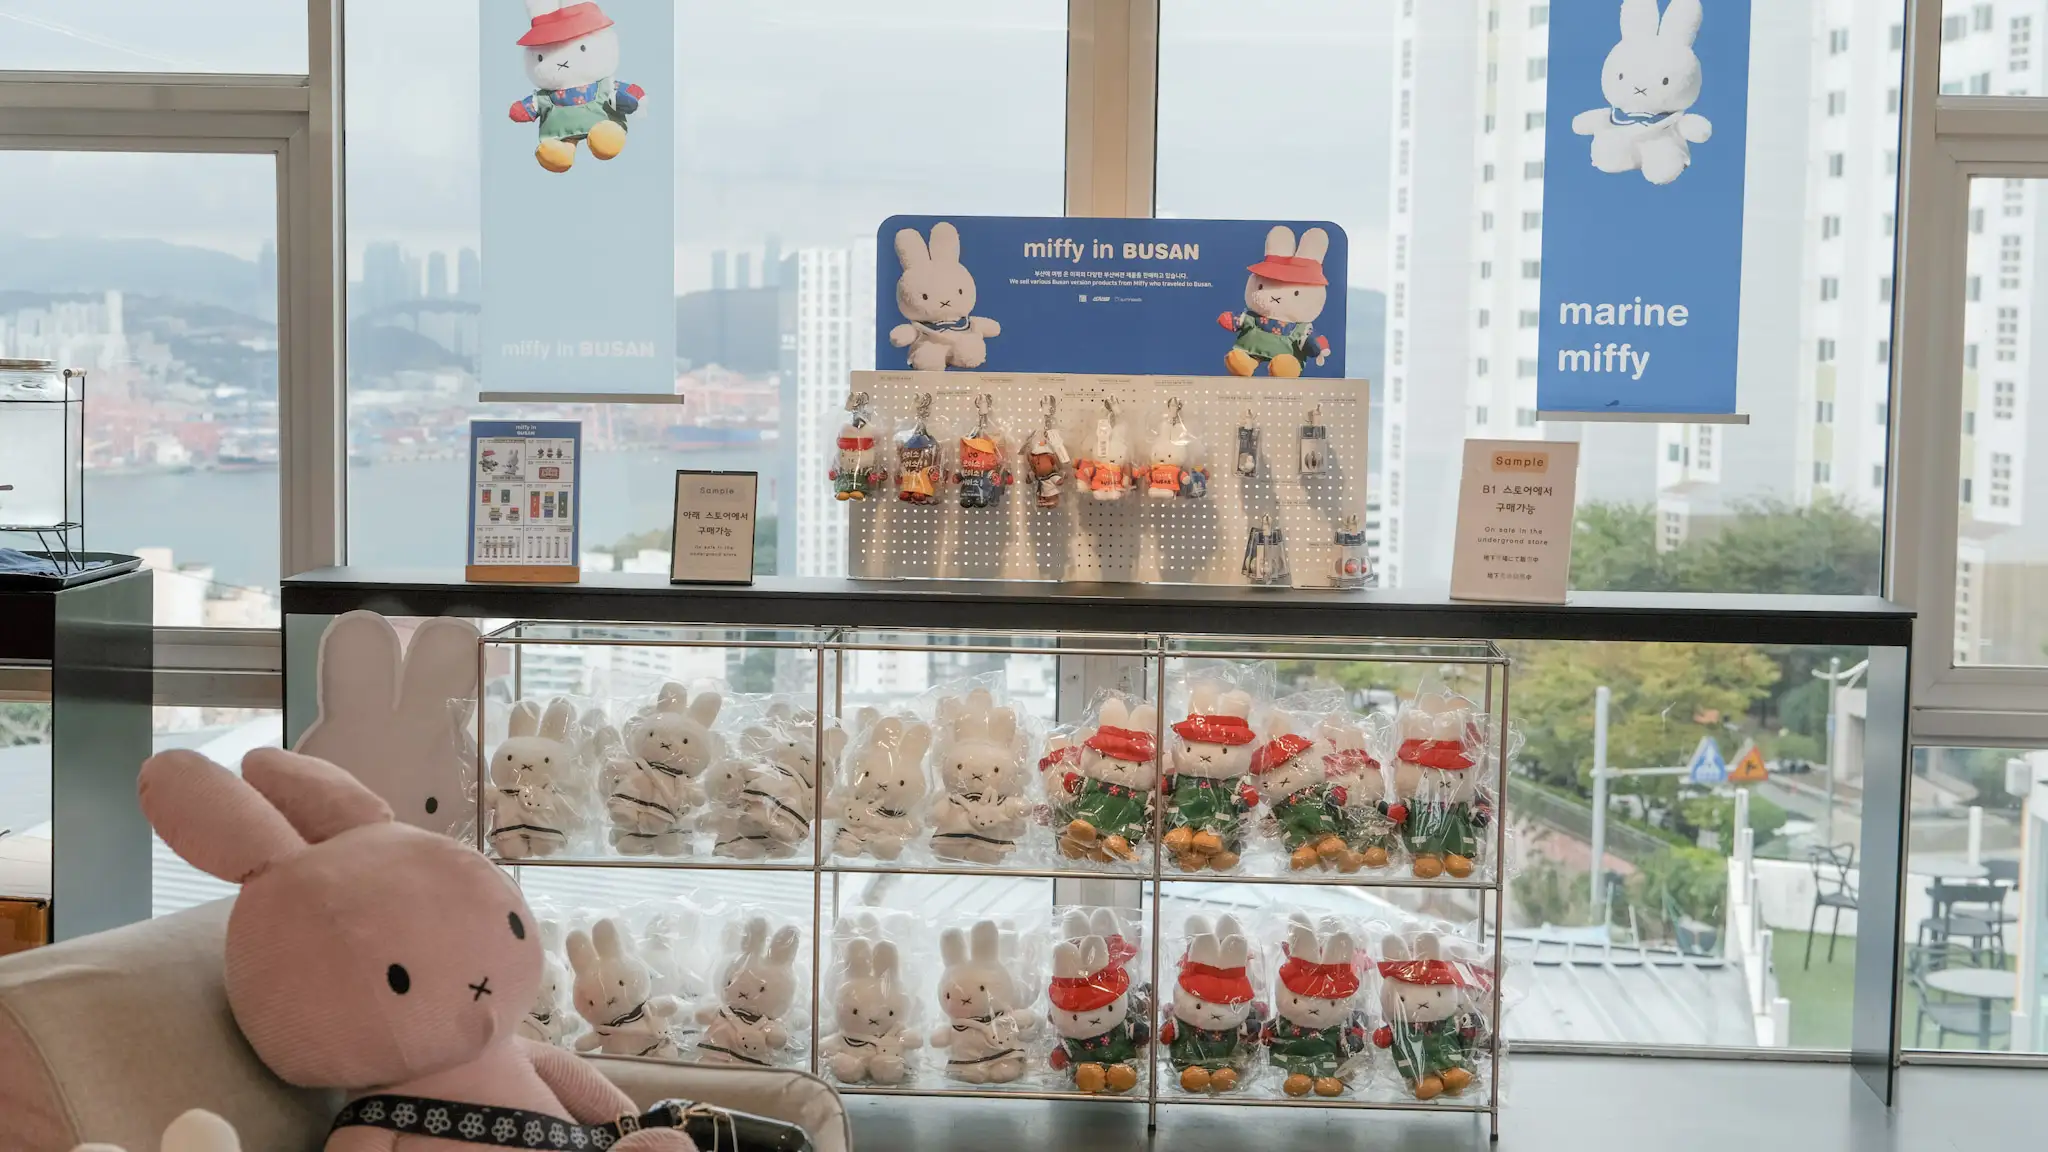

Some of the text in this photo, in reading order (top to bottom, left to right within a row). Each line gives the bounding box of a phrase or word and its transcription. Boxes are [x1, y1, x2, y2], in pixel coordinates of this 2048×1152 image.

[1024, 238, 1199, 263] miffy in BUSAN
[1560, 296, 1689, 327] marine
[502, 340, 655, 359] miffy in BUSAN
[1559, 343, 1650, 380] miffy
[1496, 456, 1544, 467] Sample
[700, 487, 734, 495] Sample
[1482, 484, 1553, 496] B1 스토어에서
[1496, 502, 1536, 515] 구매가능
[683, 511, 748, 520] 아래 스토어에서
[698, 527, 732, 537] 구매가능
